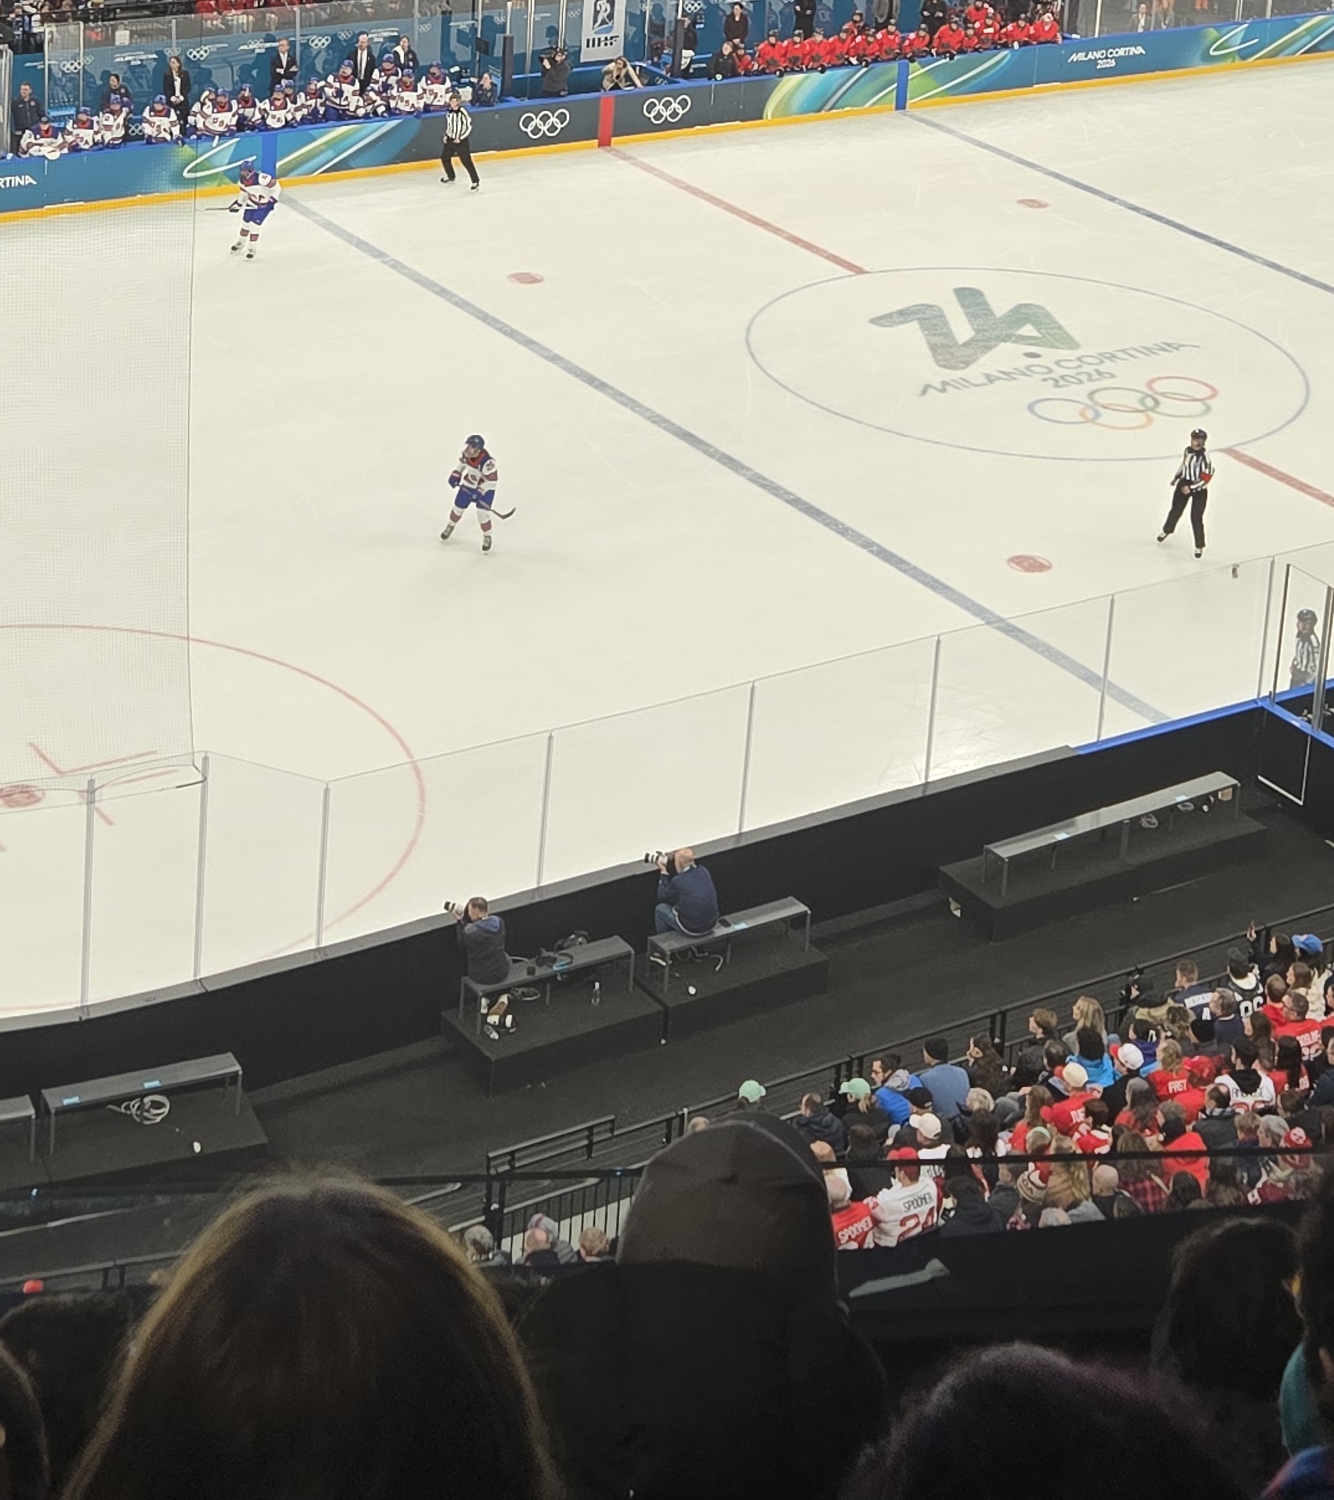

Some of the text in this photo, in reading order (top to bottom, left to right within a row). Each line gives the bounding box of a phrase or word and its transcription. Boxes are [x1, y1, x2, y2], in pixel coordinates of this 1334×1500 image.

[586, 35, 619, 48] IIHF
[1067, 46, 1146, 63] MILANO CORTINA
[868, 287, 1082, 371] 26
[918, 340, 1201, 398] MILANO CORTINA
[1042, 368, 1116, 389] 2026
